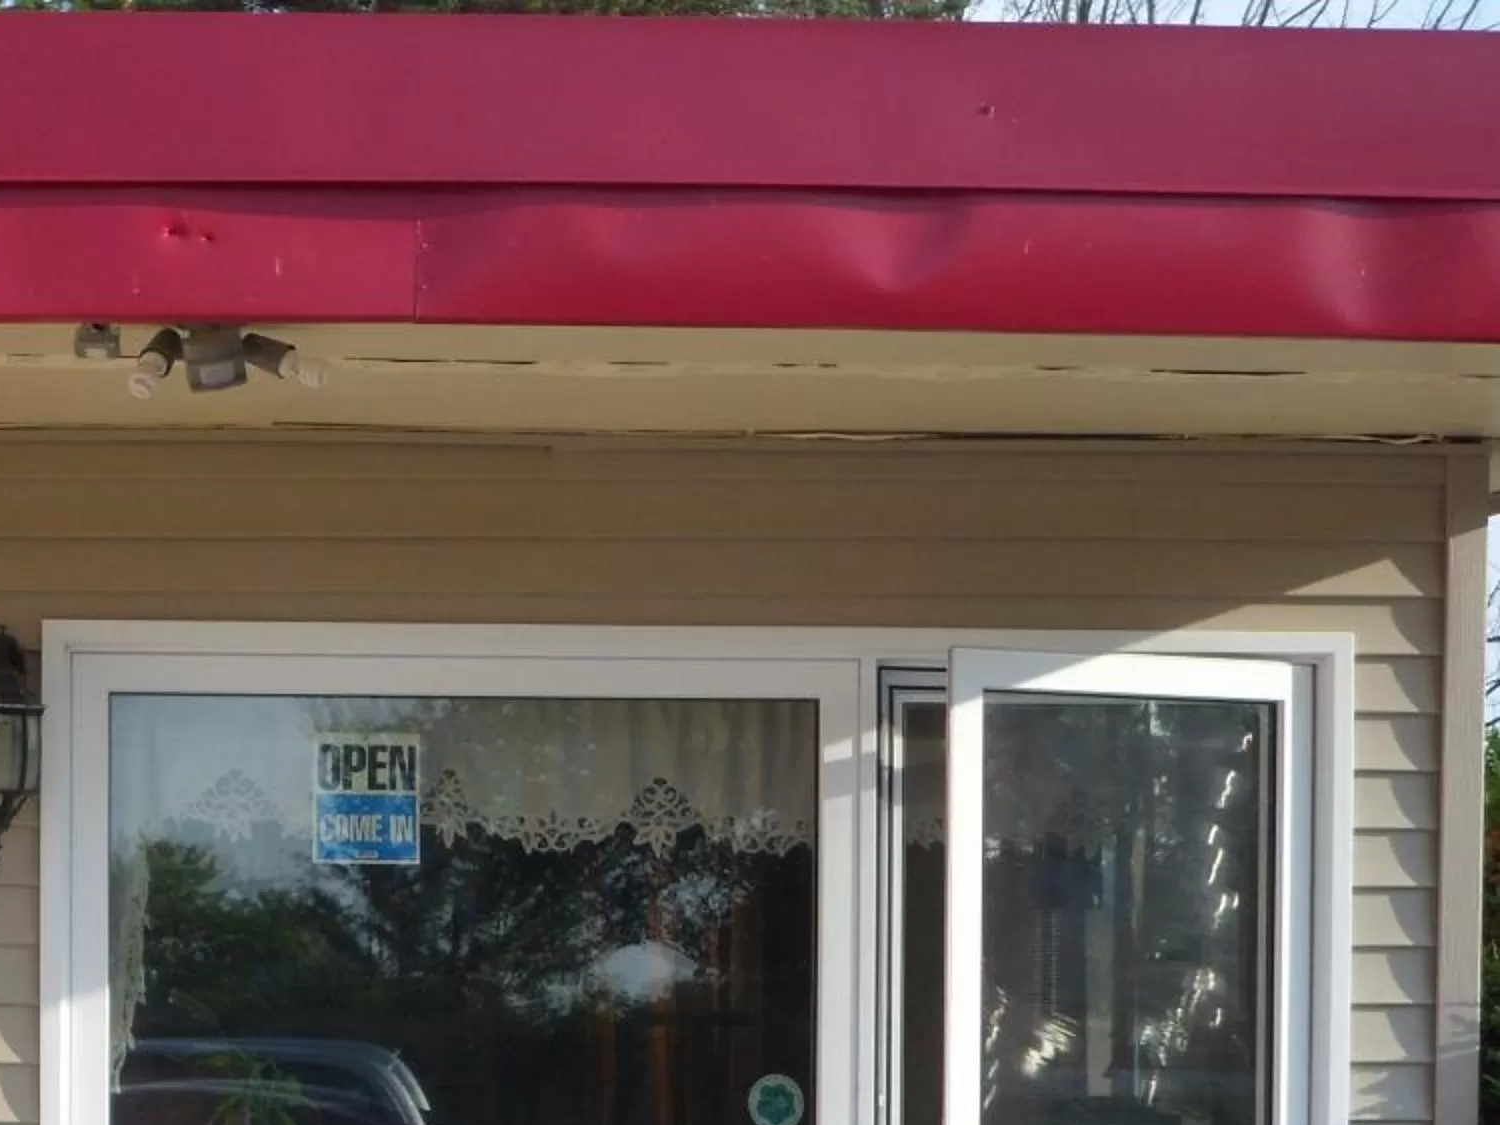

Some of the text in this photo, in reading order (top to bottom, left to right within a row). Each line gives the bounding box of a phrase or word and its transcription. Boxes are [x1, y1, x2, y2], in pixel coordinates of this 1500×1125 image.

[318, 743, 417, 791] OPEN
[319, 813, 414, 846] COME IN
